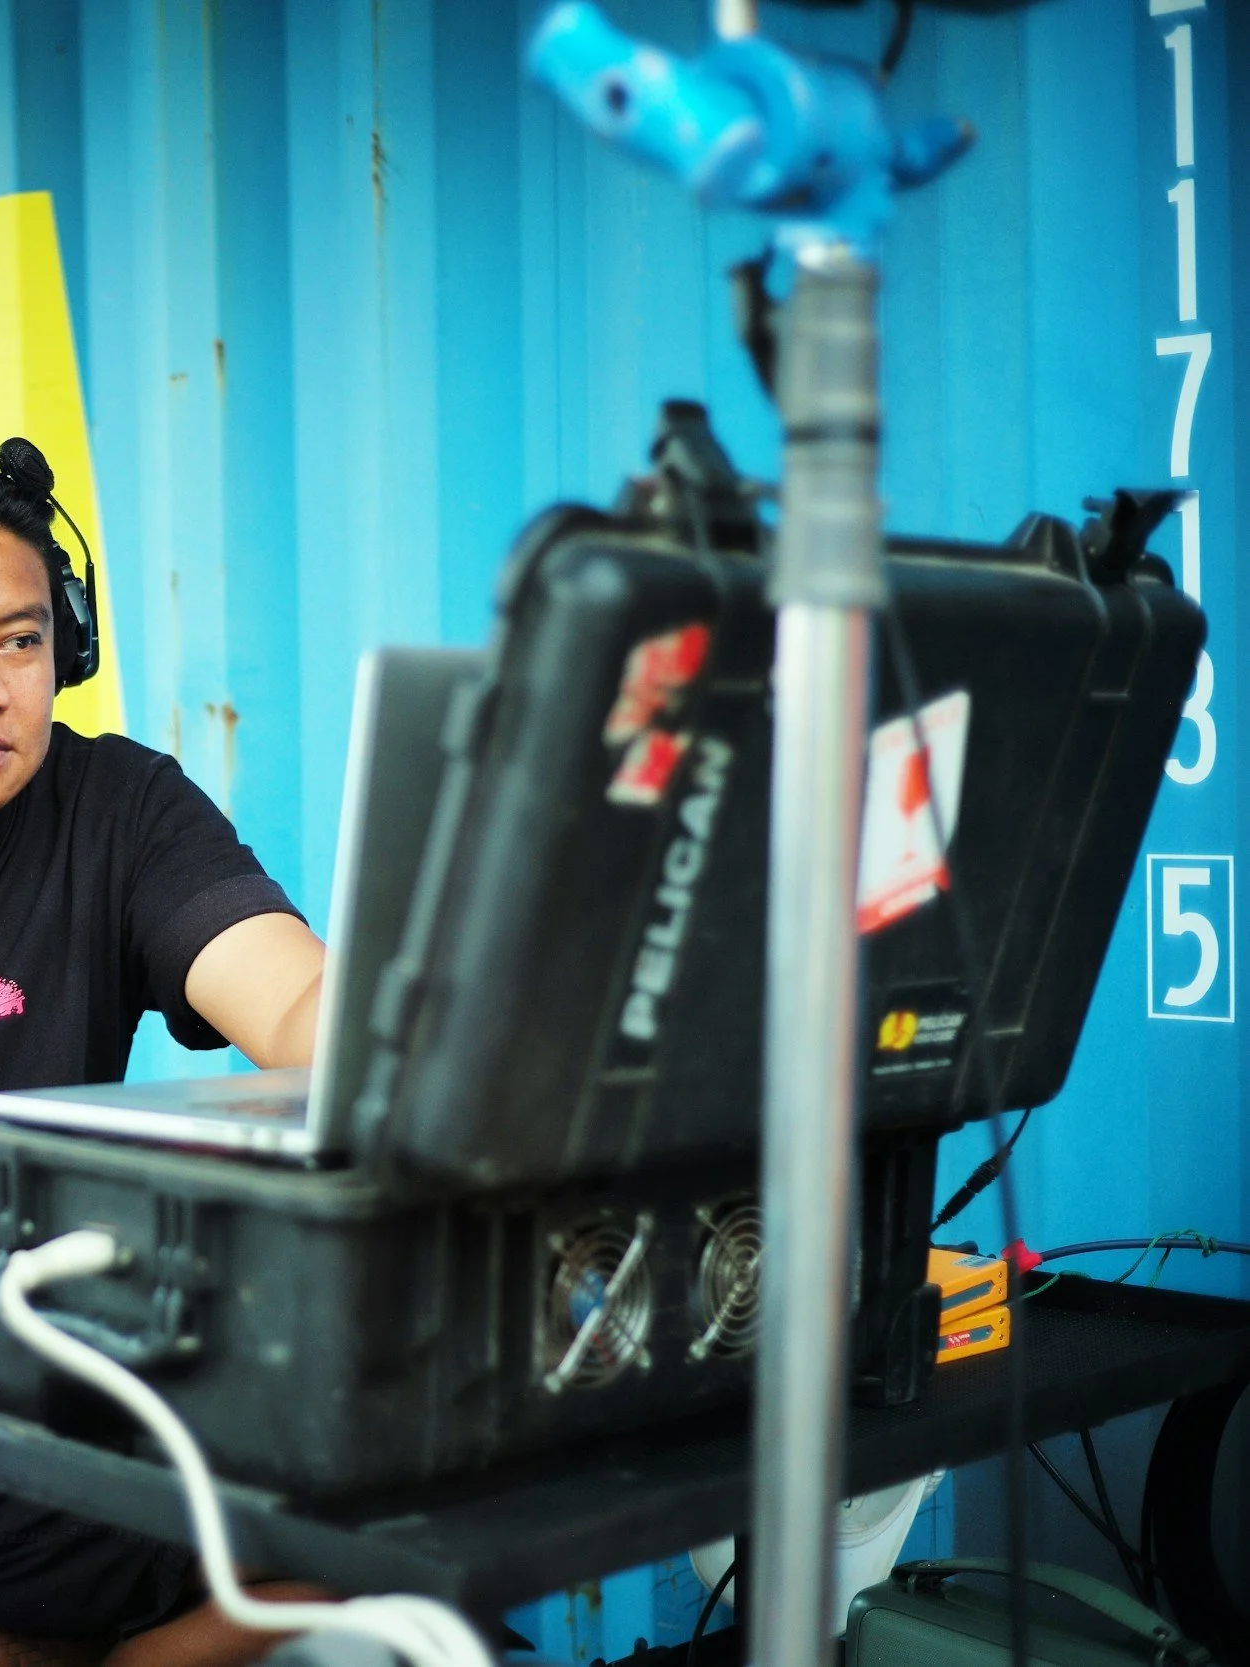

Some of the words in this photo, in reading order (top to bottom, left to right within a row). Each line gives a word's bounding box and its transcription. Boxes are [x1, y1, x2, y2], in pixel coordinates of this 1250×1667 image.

[1148, 0, 1216, 785] 11713
[619, 736, 734, 1040] PELICAN
[1162, 866, 1218, 1006] 5
